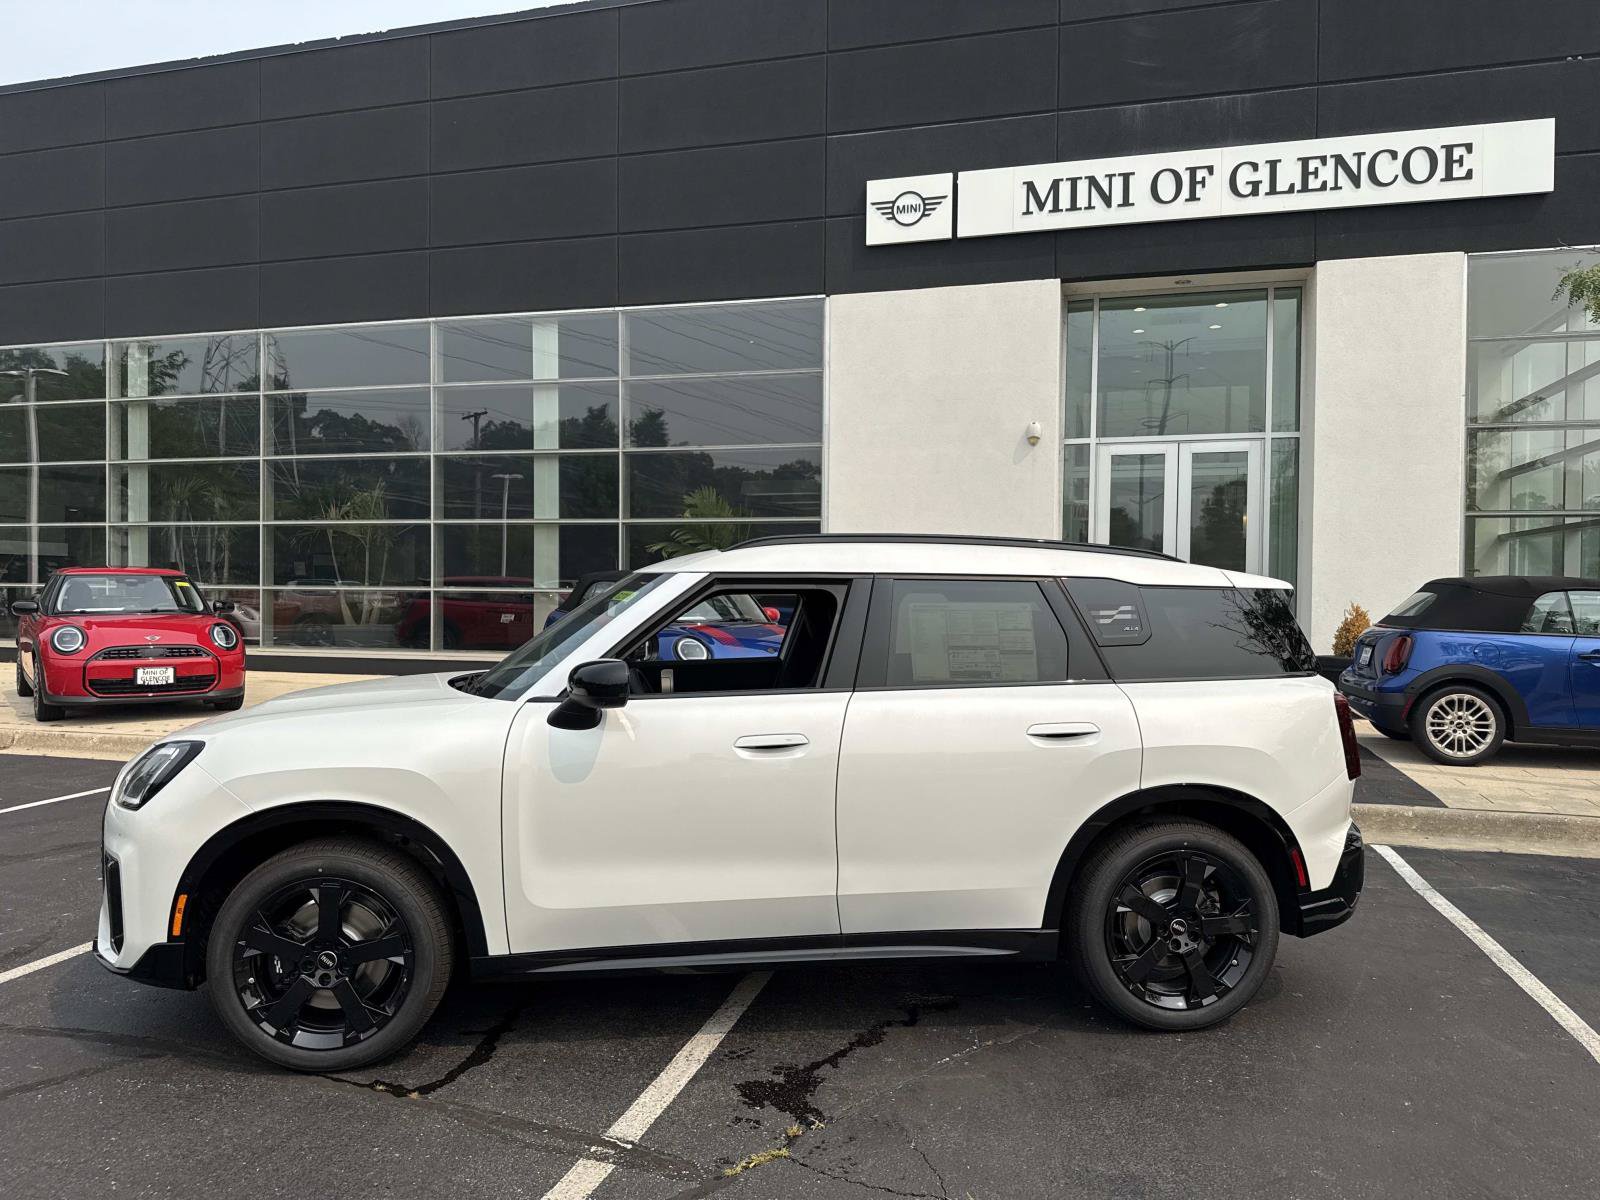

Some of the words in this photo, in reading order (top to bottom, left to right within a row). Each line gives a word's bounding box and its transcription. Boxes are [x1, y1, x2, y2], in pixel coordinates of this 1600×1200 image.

[1021, 172, 1135, 216] MINI
[1150, 165, 1214, 204] OF
[1228, 142, 1474, 199] GLENCOE
[896, 204, 922, 214] MINI
